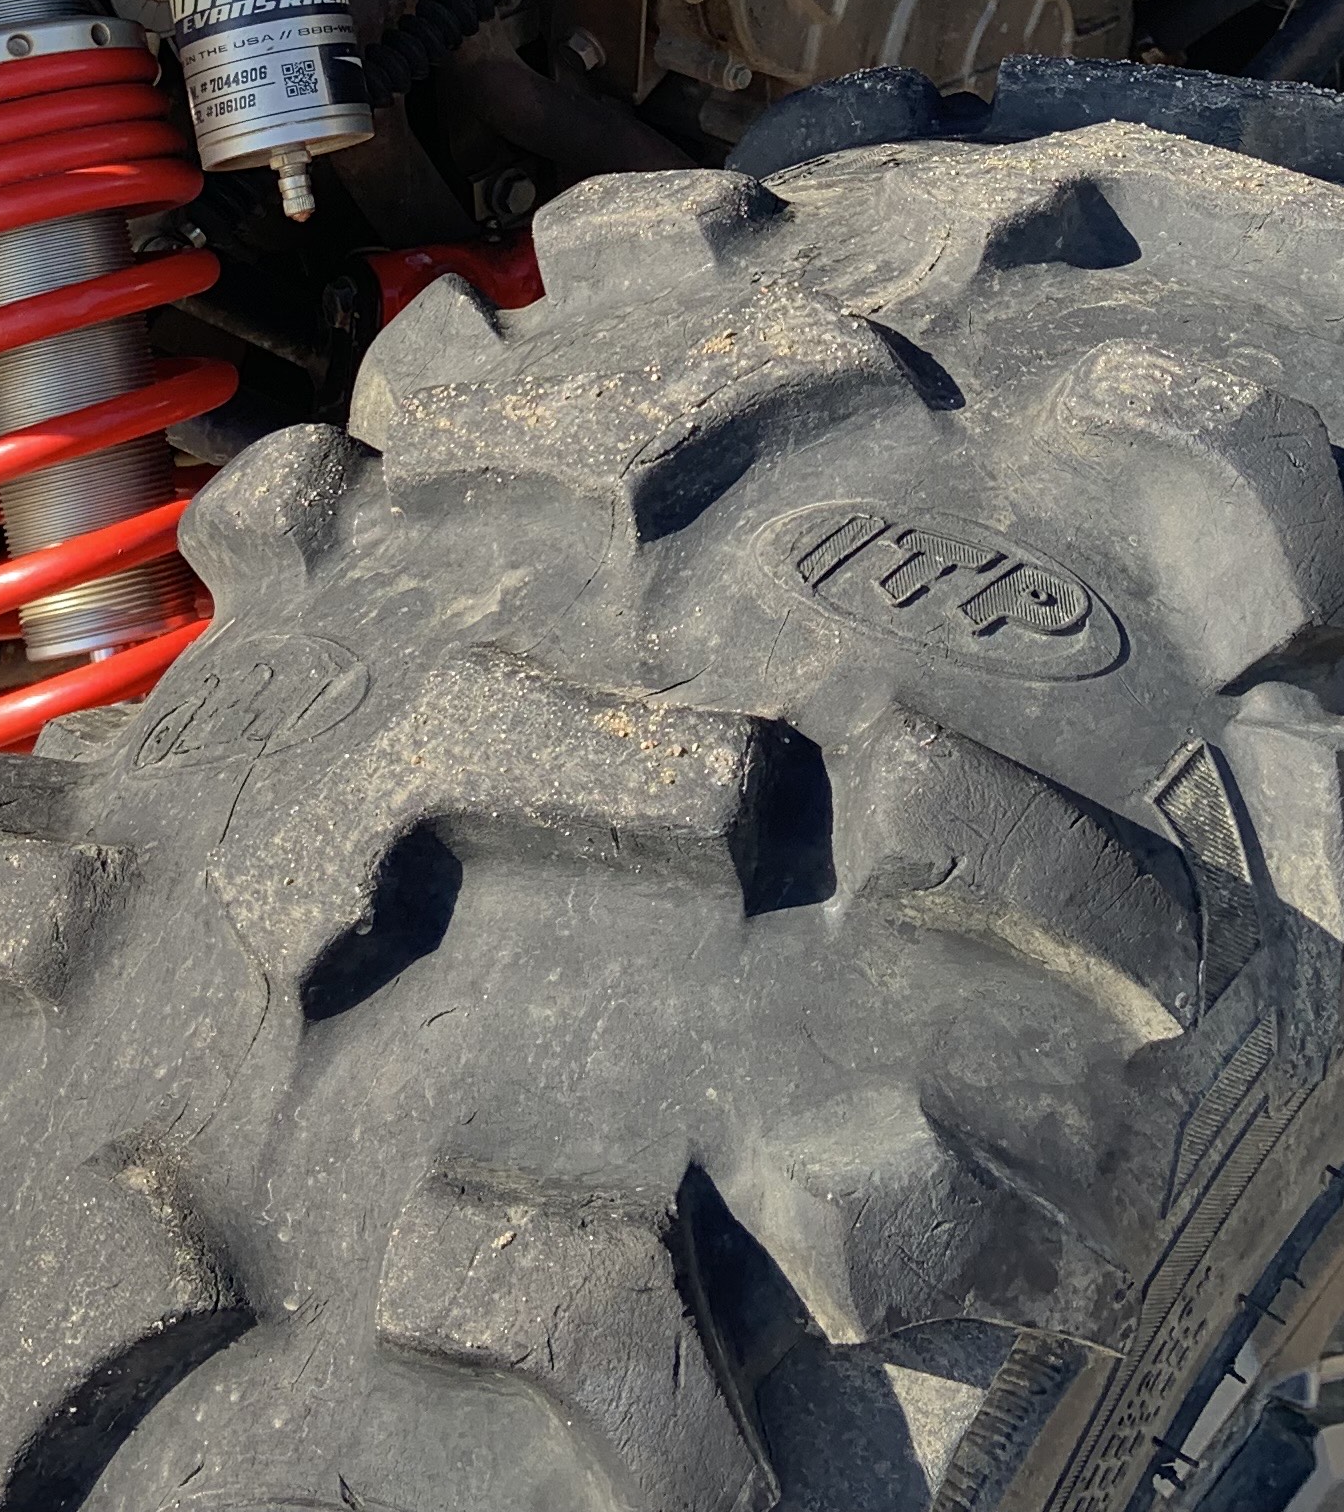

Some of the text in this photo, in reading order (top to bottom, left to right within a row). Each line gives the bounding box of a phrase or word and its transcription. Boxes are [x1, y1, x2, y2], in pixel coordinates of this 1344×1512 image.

[199, 44, 229, 60] THE
[233, 34, 274, 49] USA
[798, 513, 1093, 637] ITP
